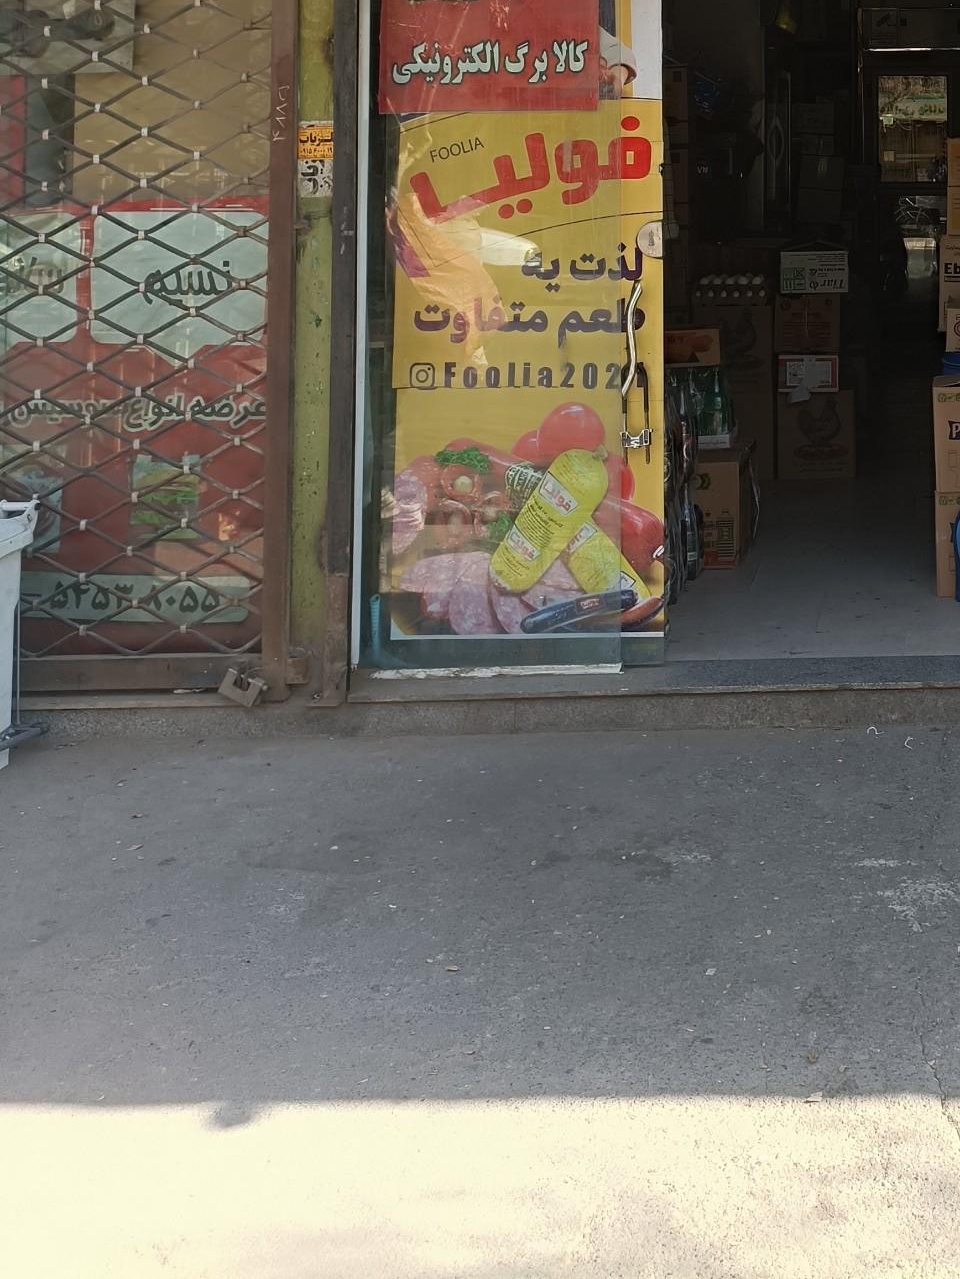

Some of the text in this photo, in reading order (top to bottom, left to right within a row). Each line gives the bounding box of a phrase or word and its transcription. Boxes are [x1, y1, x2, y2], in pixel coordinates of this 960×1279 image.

[392, 39, 589, 85] کالا برگ الکترونیکی
[299, 132, 333, 147] لزیاب
[429, 137, 485, 163] FOOLIA
[409, 116, 652, 225] فولیا
[570, 242, 643, 281] لذت
[414, 297, 646, 349] طعم متفاوت
